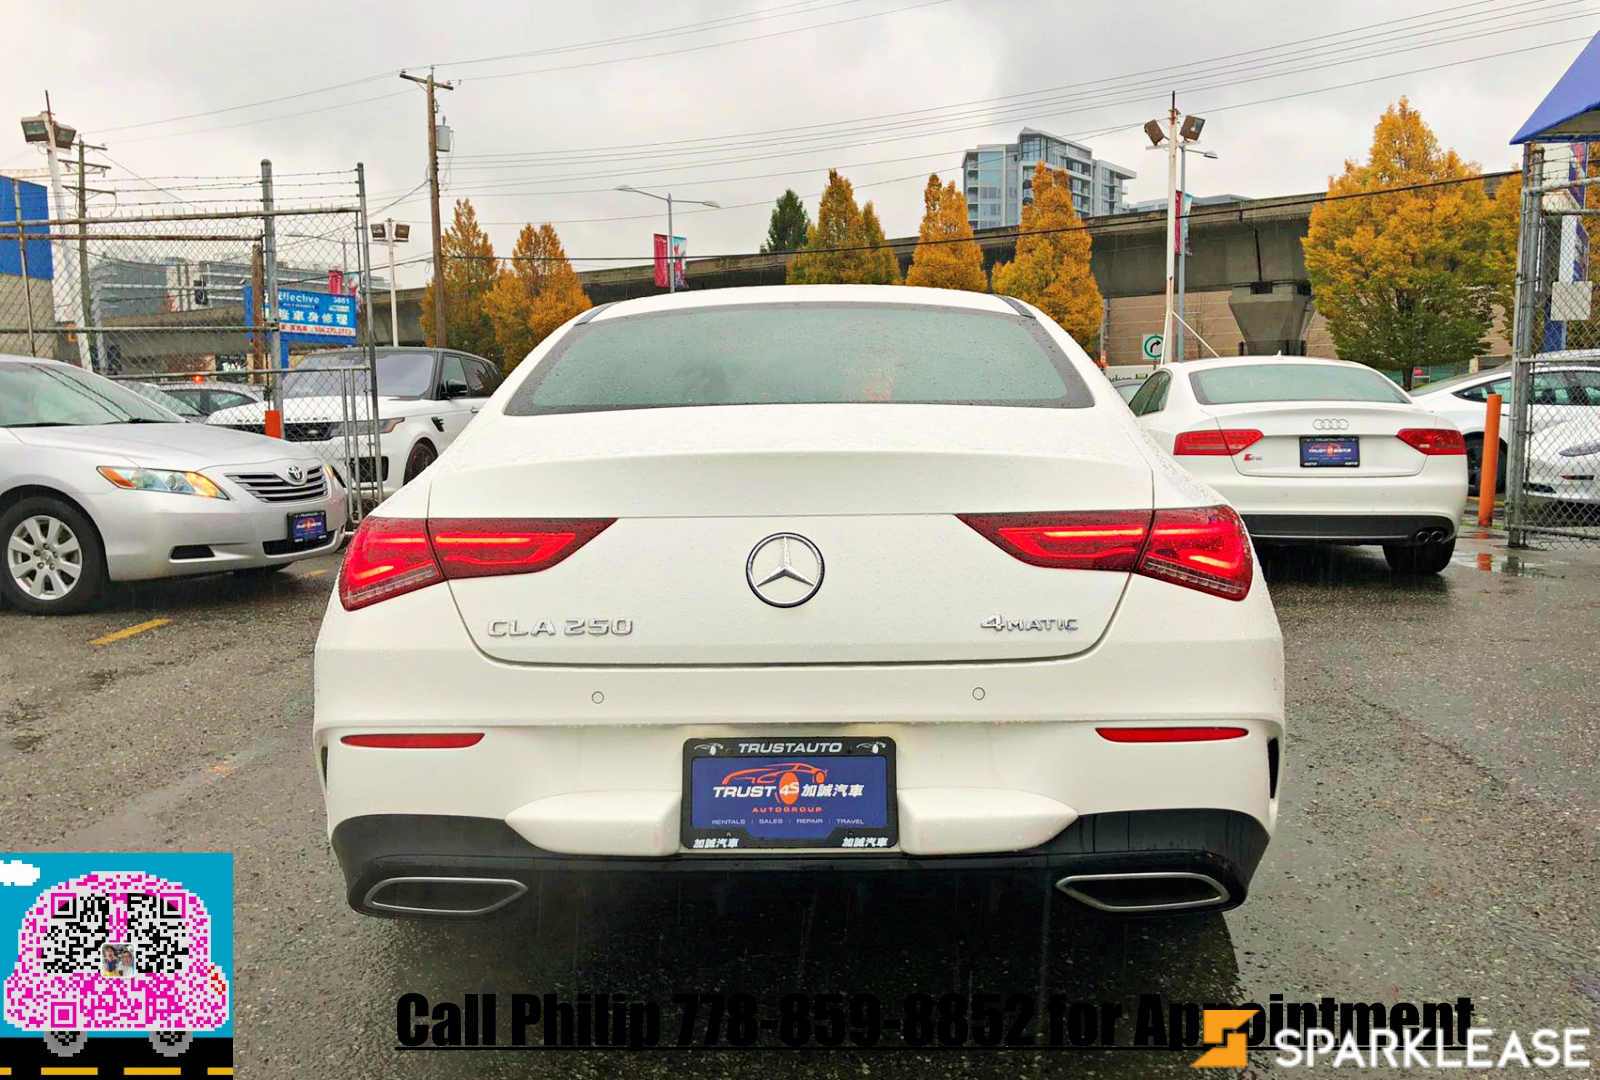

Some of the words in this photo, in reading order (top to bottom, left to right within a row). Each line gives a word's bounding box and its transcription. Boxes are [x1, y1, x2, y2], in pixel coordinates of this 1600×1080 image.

[488, 617, 556, 637] CLA
[563, 617, 633, 637] 250
[980, 614, 1079, 632] 4MATIC
[738, 742, 843, 754] TRUSTAUTO
[713, 785, 777, 798] TRUST
[752, 806, 823, 814] AUTOGROUP
